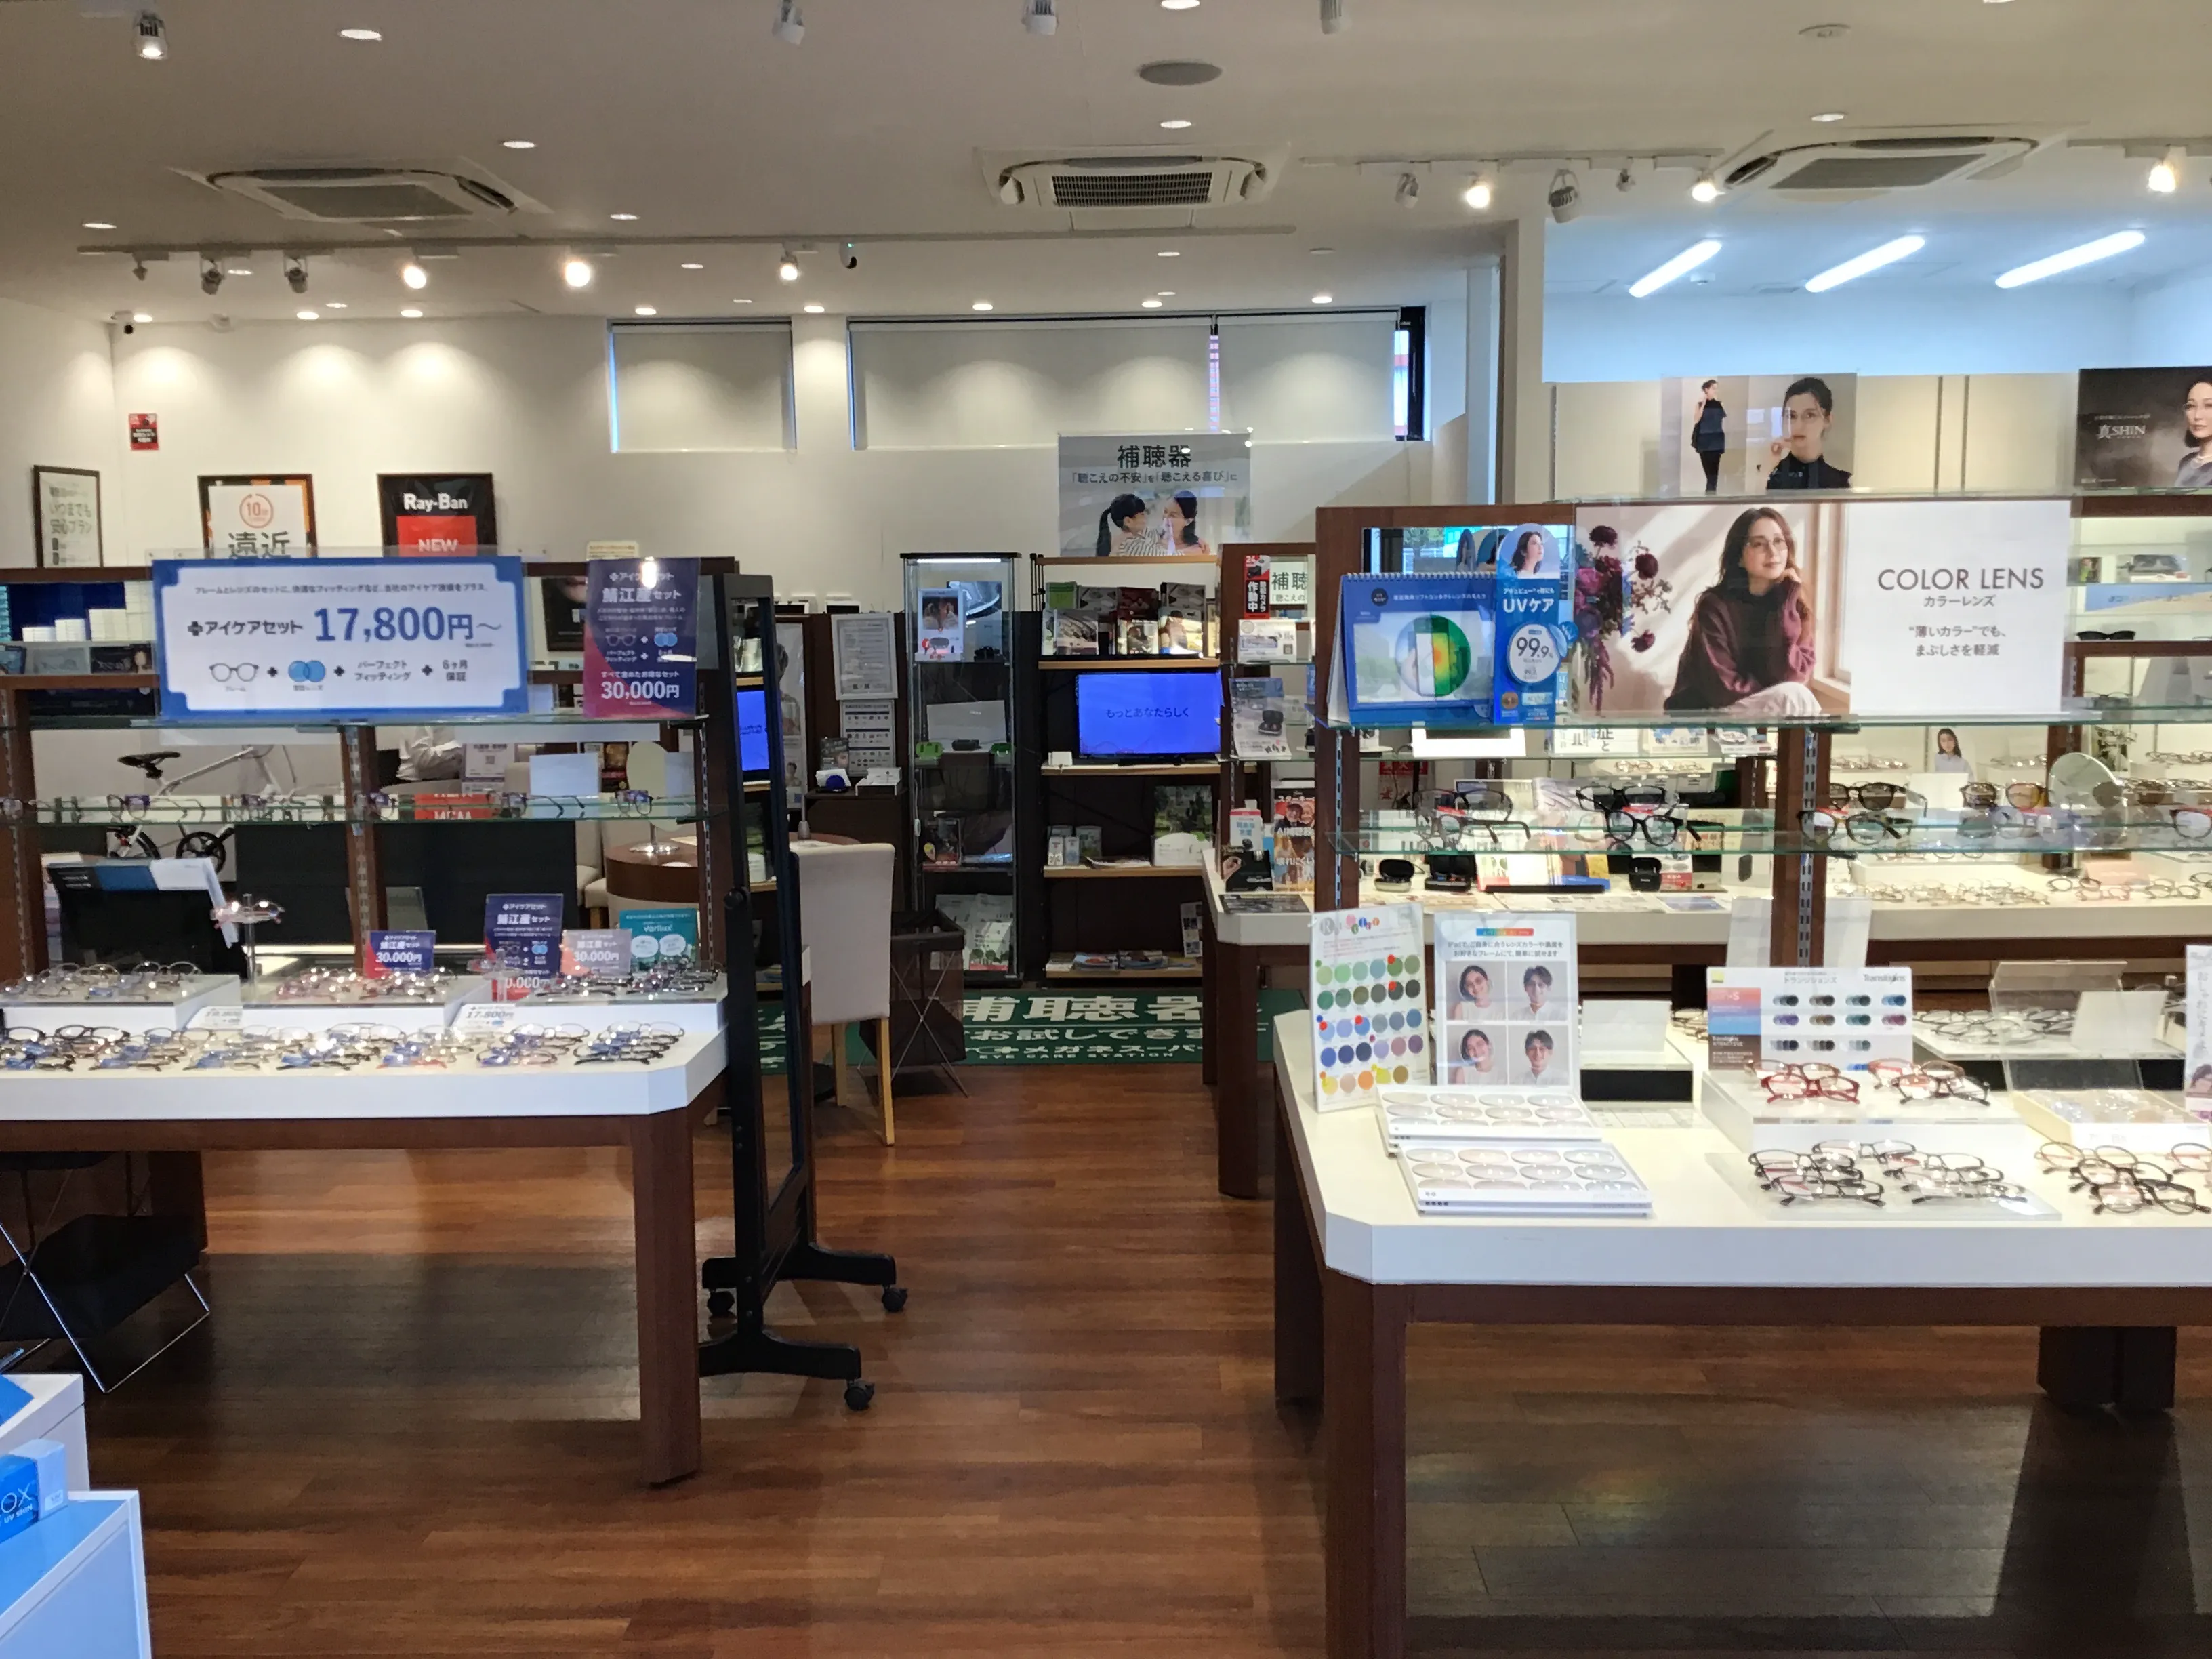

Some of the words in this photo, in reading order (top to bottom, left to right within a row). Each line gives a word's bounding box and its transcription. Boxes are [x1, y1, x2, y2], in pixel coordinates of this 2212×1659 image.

[1117, 445, 1191, 468] 補聴器
[403, 493, 468, 512] Ray-Ban
[418, 539, 457, 552] NEW
[1878, 568, 1969, 590] COLOR
[1981, 567, 2044, 589] LENS
[1503, 598, 1555, 613] UVケア
[1924, 596, 1996, 607] カラーレンズ
[205, 620, 303, 636] アイケアセット
[1915, 644, 2000, 657] まぶしさを軽減
[358, 661, 407, 669] パーフェクト
[354, 672, 411, 681] フィッティング
[446, 672, 466, 681] 保証
[601, 681, 680, 699] 30,000円
[1106, 707, 1189, 718] もっとあなたらしく
